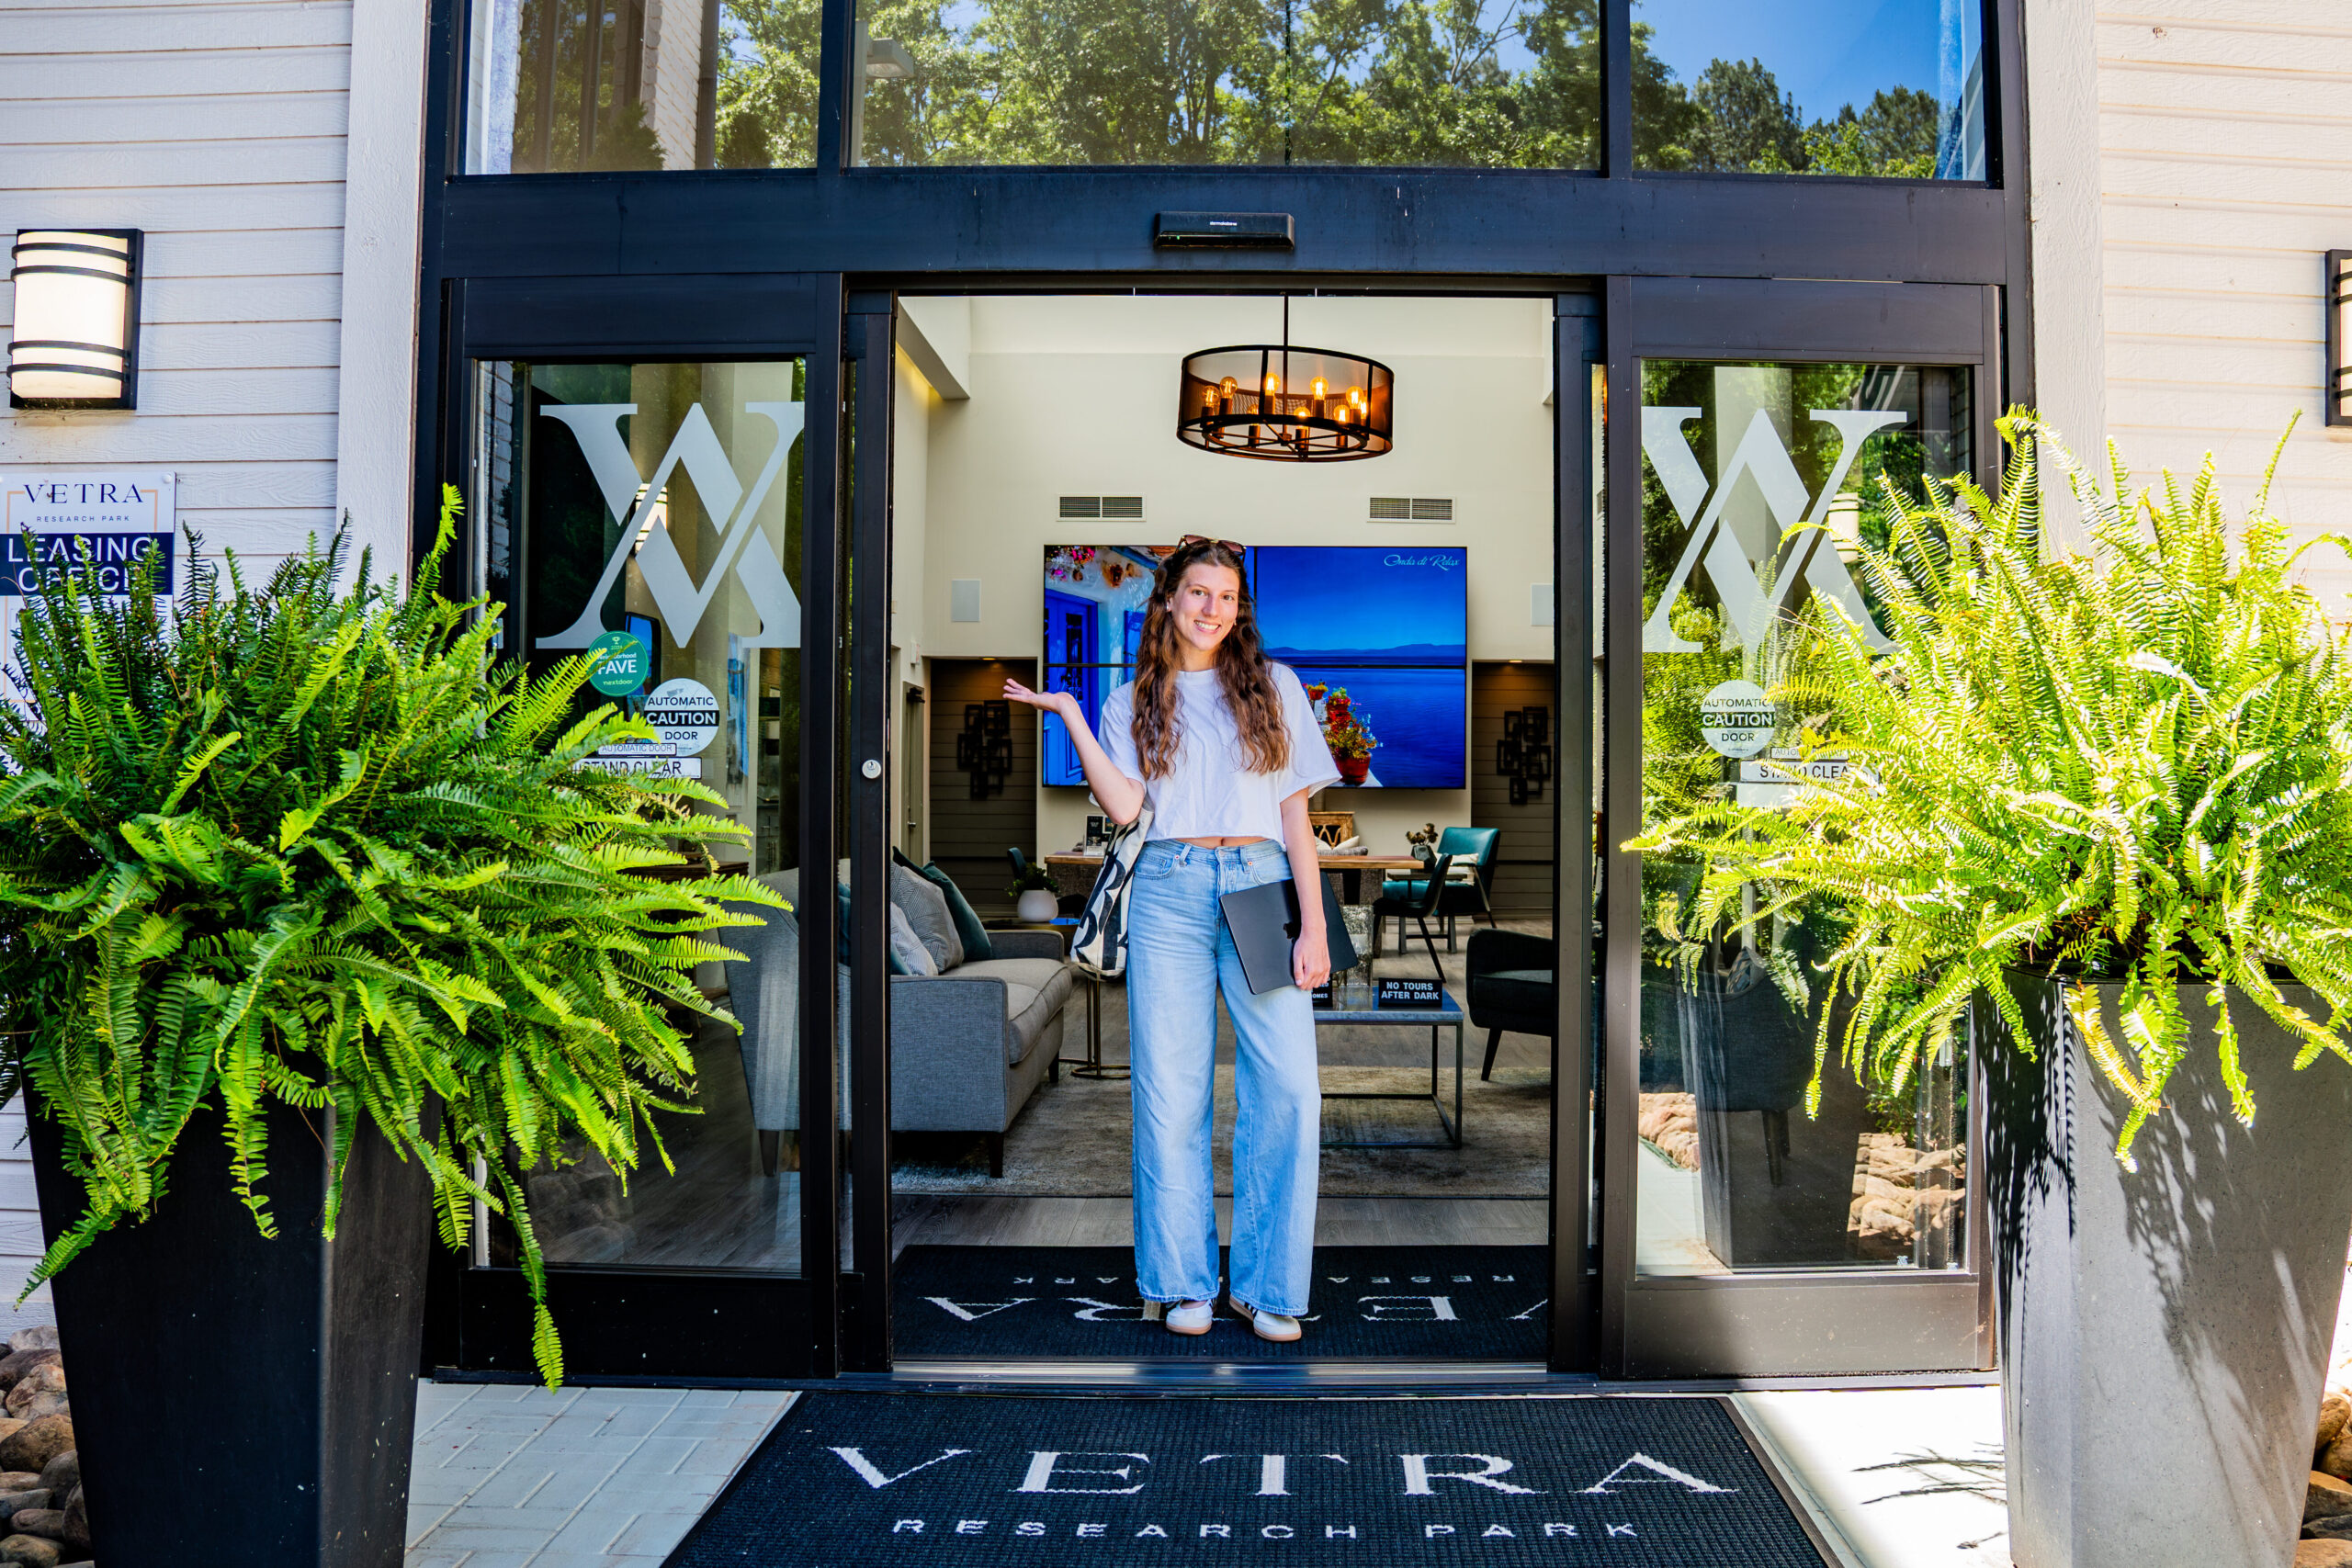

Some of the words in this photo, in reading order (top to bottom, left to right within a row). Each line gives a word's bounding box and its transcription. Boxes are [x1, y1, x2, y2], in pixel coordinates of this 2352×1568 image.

[23, 483, 143, 504] VETRA
[1417, 556, 1428, 566] di
[597, 660, 638, 674] FAVE
[648, 696, 713, 706] AUTOMATIC
[1704, 698, 1770, 707] AUTOMATIC
[646, 712, 717, 725] CAUTION
[1702, 714, 1772, 726] CAUTION
[664, 731, 698, 740] DOOR
[1722, 732, 1755, 742] DOOR
[602, 744, 647, 752] AUTOMATIC
[649, 744, 673, 752] DOOR
[634, 761, 682, 774] CLAR
[1812, 765, 1849, 779] CLEA
[1386, 981, 1399, 990] NO
[1403, 982, 1433, 991] TOURS
[1381, 990, 1410, 999] AFTER
[1414, 991, 1439, 1000] DARK
[823, 1447, 1739, 1495] VETRA
[893, 1518, 1357, 1539] RESEARCH
[1426, 1522, 1638, 1539] PARK
